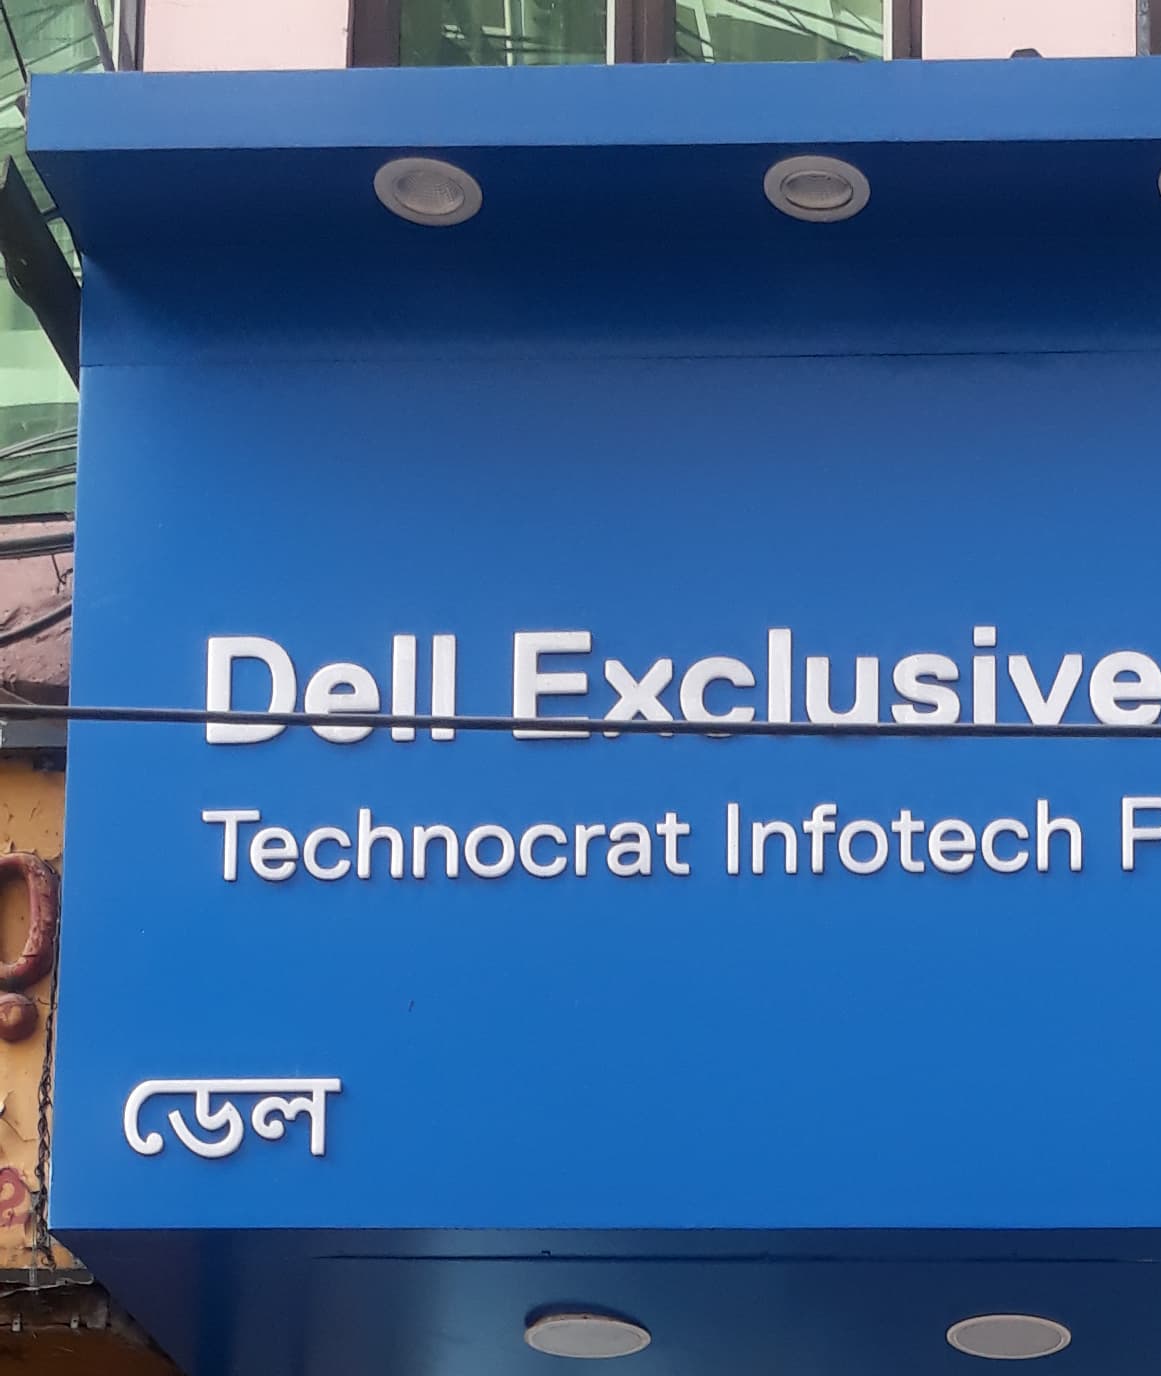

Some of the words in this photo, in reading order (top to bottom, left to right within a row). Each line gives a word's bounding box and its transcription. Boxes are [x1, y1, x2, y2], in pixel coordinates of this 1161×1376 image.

[204, 633, 458, 745] Dell
[201, 806, 691, 883] Technocrat
[725, 799, 1084, 876] Infotech
[122, 1075, 342, 1160] ডেল
